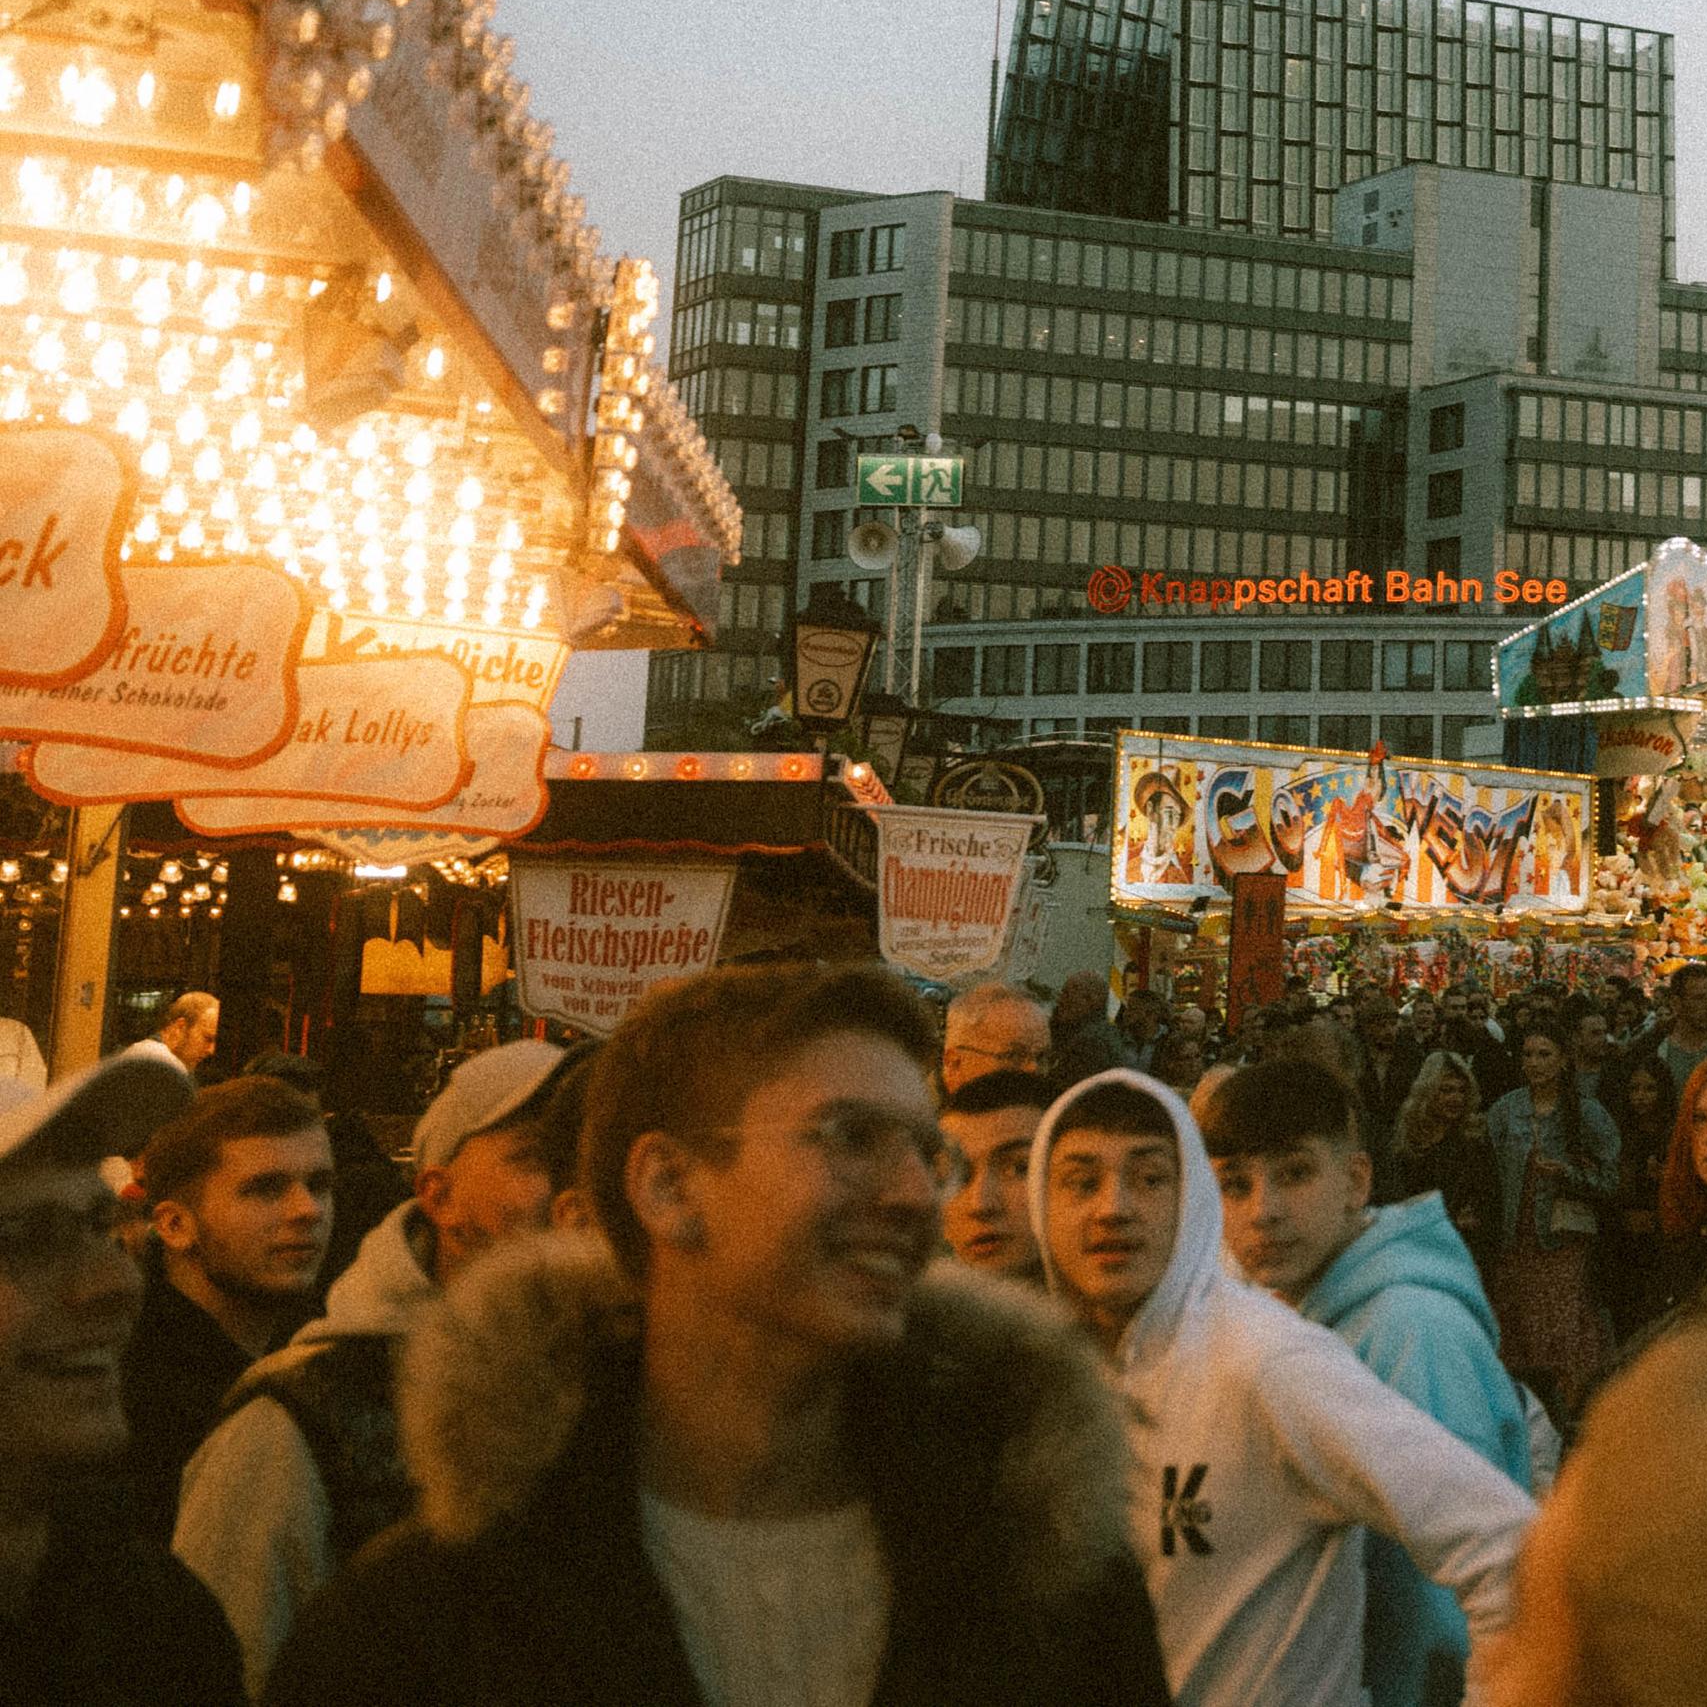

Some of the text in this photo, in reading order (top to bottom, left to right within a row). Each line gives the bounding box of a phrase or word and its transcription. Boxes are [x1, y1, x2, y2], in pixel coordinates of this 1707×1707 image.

[1140, 570, 1568, 611] Knappschaft Bahn See
[112, 626, 258, 680] früchte
[110, 680, 228, 712] Schokolade
[296, 707, 434, 757] ak Lollys
[915, 830, 991, 858] Frische
[1206, 766, 1540, 910] GO WEST
[568, 873, 675, 917] Riesen-
[527, 918, 709, 973] Fleischspieße
[542, 973, 575, 991] vom
